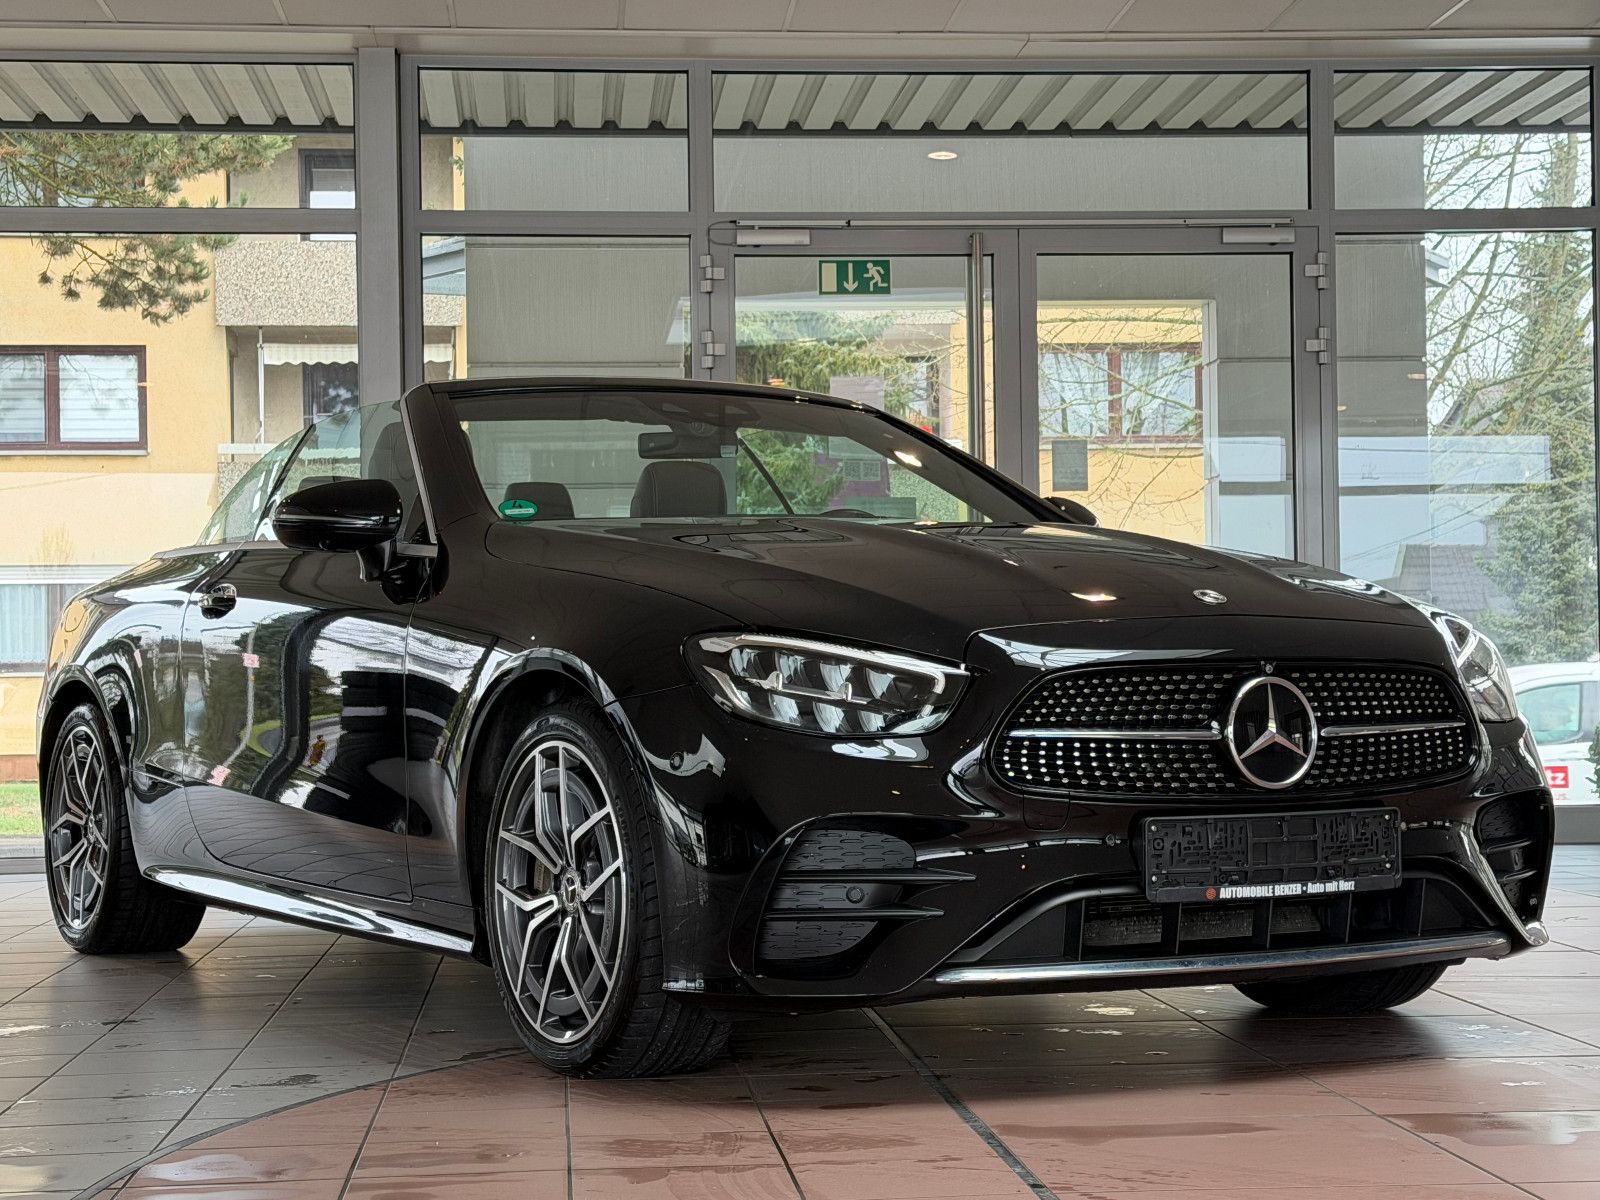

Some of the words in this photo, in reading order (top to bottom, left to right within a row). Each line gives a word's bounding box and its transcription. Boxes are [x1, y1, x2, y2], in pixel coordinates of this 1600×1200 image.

[1220, 885, 1273, 898] AUTOMOBILE
[1307, 882, 1325, 893] Auto
[1325, 880, 1338, 892] mit
[1338, 880, 1355, 891] Herz
